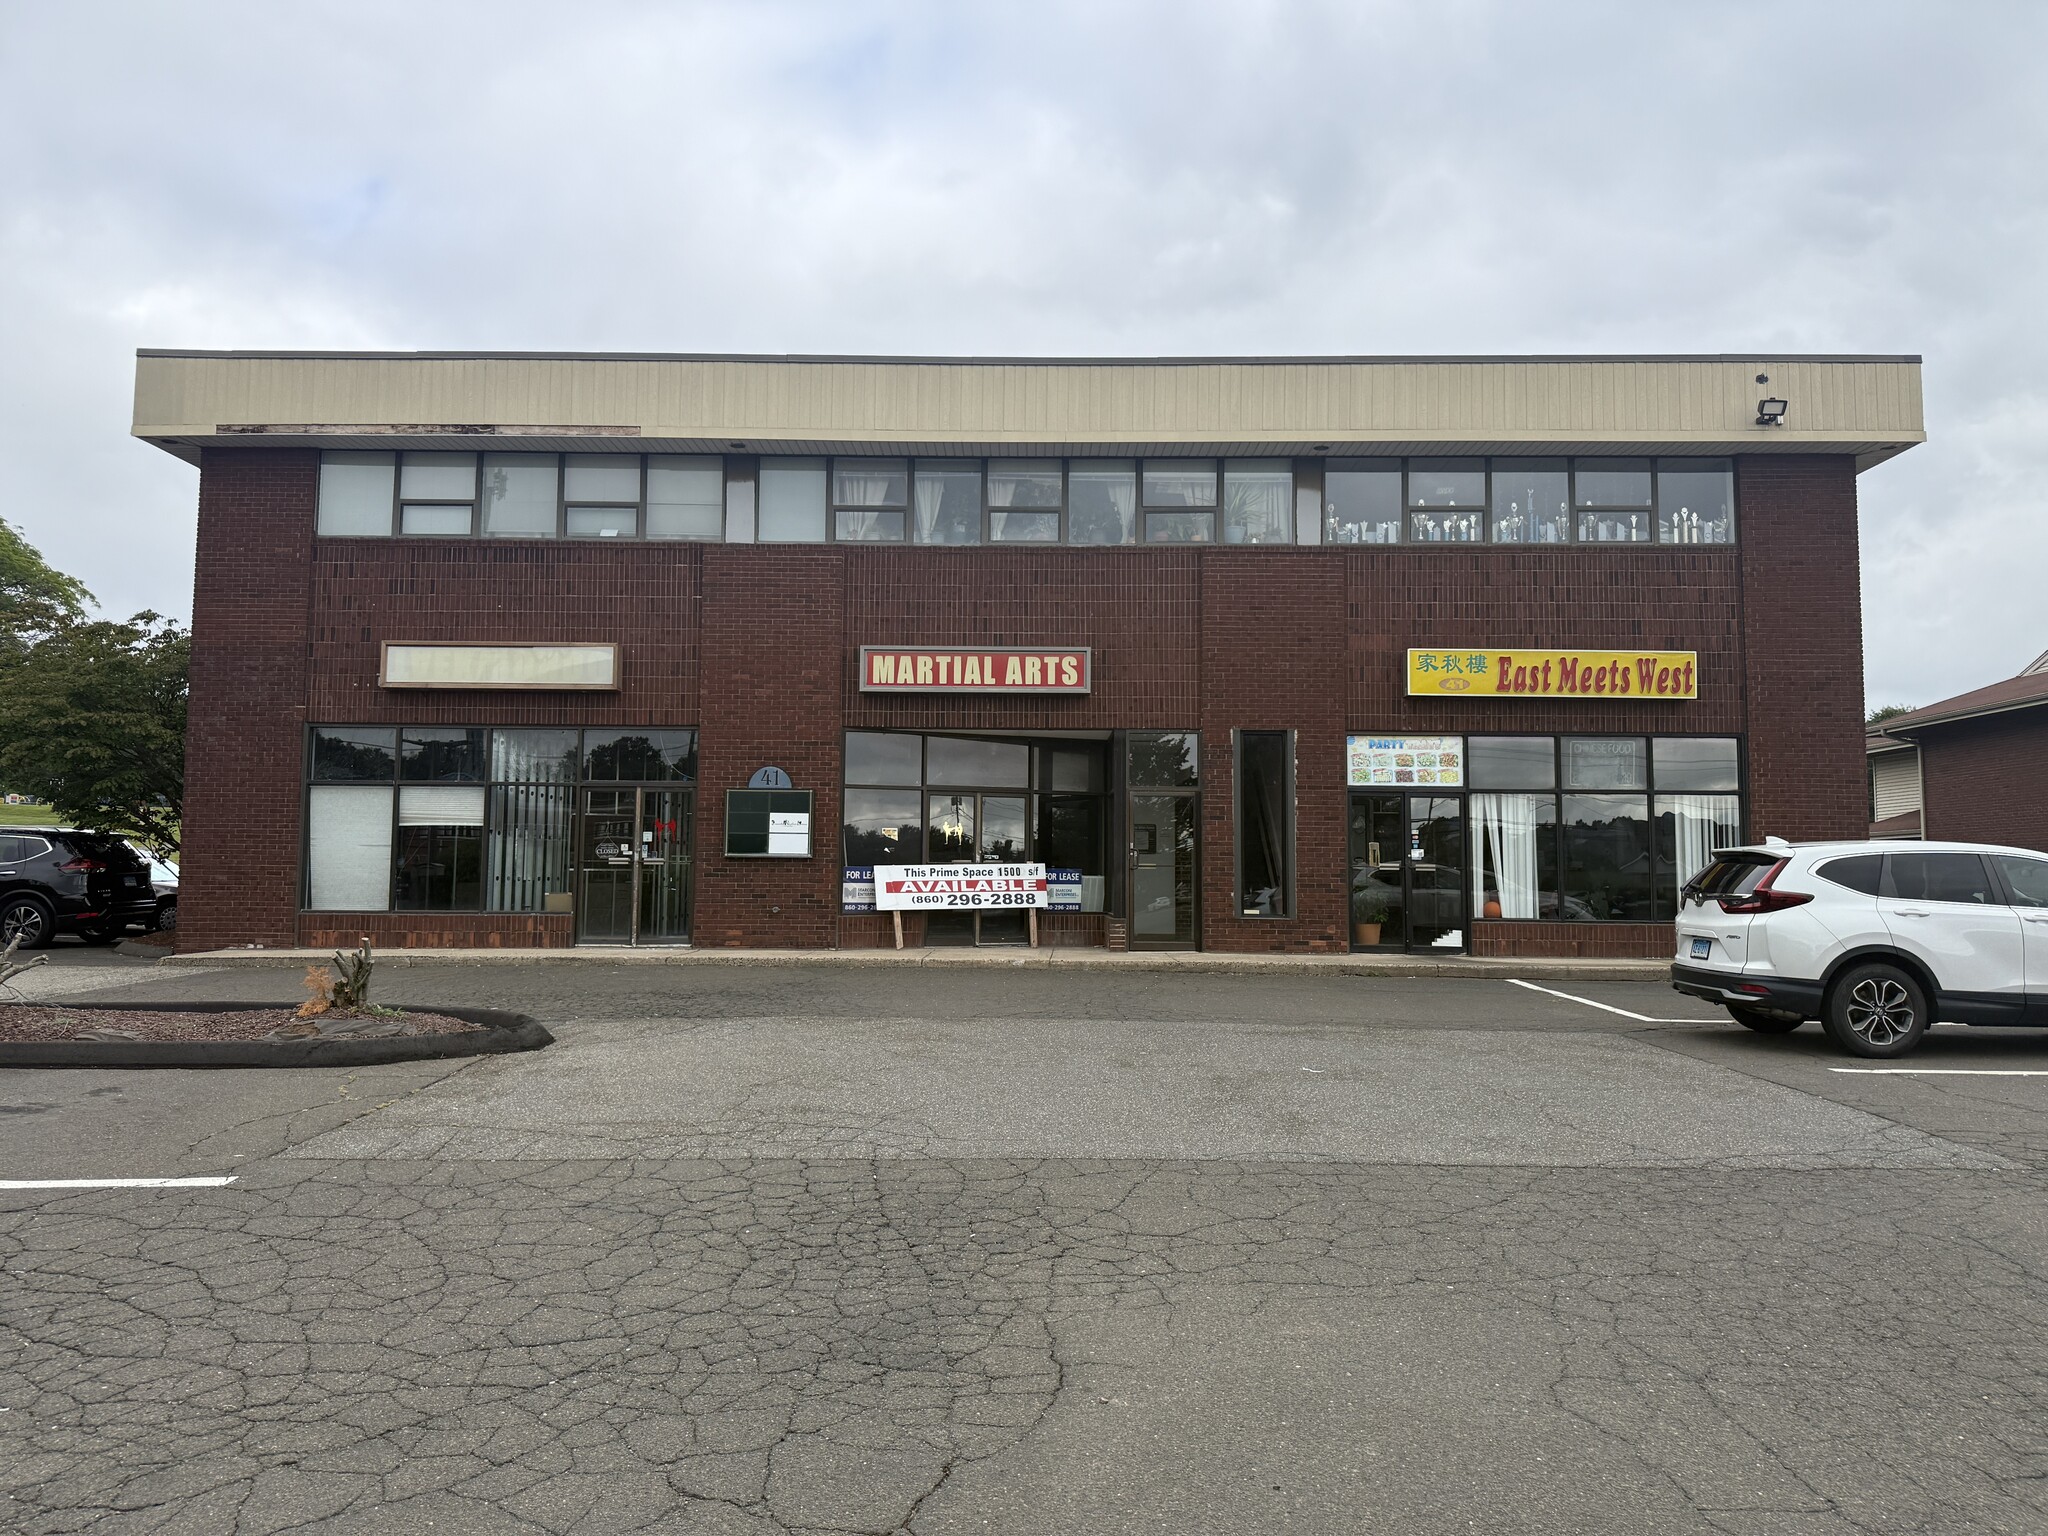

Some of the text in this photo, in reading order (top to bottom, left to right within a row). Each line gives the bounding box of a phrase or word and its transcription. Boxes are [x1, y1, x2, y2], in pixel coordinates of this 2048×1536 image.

[872, 655, 1078, 685] MARTIAL ARTS
[1495, 656, 1693, 695] East Meets West
[1445, 679, 1465, 690] 41
[1368, 739, 1405, 750] PARTY
[760, 769, 779, 786] 41
[846, 870, 875, 880] FOR LEA
[904, 867, 926, 878] This
[929, 867, 959, 877] Prime
[962, 867, 994, 879] Space
[997, 867, 1021, 877] 1500
[1059, 872, 1080, 881] LEASE
[900, 880, 1038, 892] AVAILABLE
[911, 893, 1036, 906] (860) 296-2888
